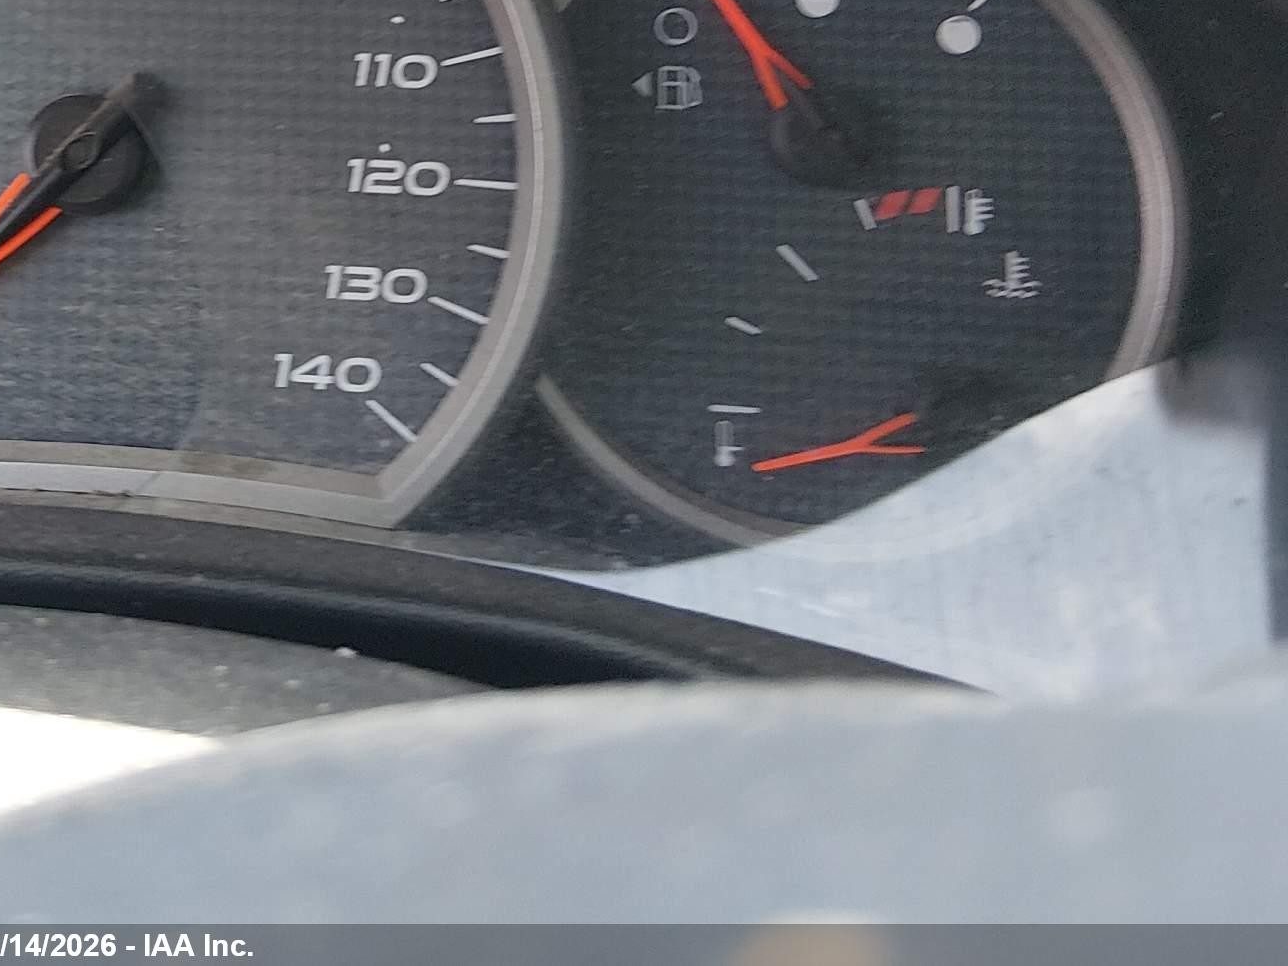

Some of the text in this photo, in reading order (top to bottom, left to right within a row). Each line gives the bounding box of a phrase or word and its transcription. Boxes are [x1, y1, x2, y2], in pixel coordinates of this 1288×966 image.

[353, 52, 438, 89] 110
[346, 158, 451, 196] 120
[324, 264, 428, 304] 130
[273, 353, 382, 392] 140
